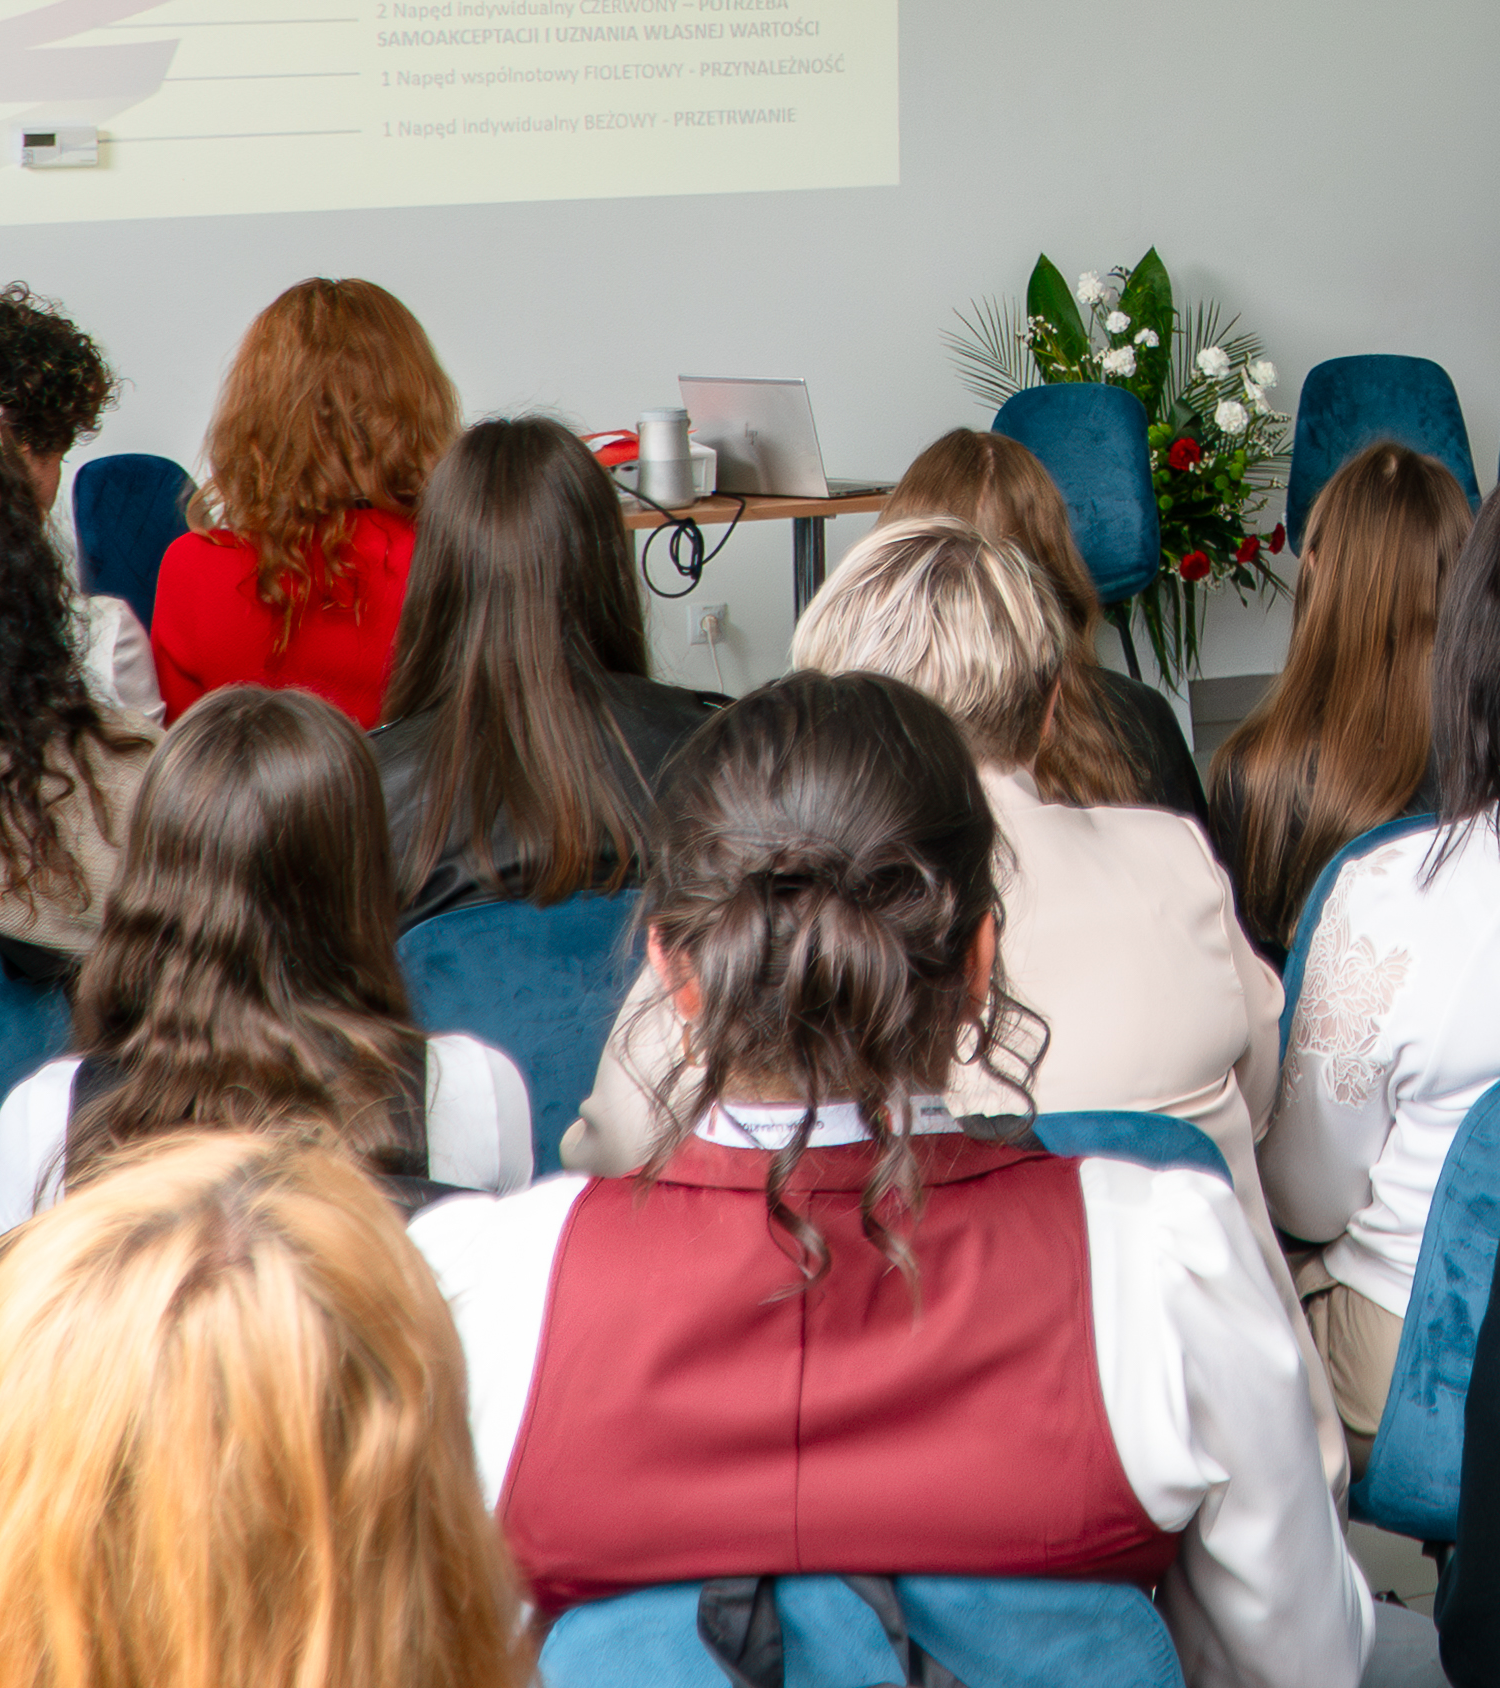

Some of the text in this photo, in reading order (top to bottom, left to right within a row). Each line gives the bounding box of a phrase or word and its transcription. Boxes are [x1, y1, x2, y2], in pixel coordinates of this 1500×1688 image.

[376, 2, 388, 20] 2
[393, 1, 453, 22] Napęd
[377, 27, 540, 48] SAMOAKCEPTACJI
[555, 25, 639, 43] UZNANIA
[643, 22, 725, 41] WŁASNEJ
[729, 17, 820, 39] WARTOŚCI
[381, 70, 391, 88] 1
[396, 68, 456, 89] Napęd
[460, 65, 580, 88] wspólnotowy
[584, 62, 685, 81] FIOLETOWY
[699, 53, 846, 78] PRZYNALEŻNOŚĆ
[383, 121, 393, 138] 1
[398, 118, 458, 140] Napęd
[462, 114, 580, 137] indywidualny
[584, 110, 658, 131] BEŻOWY
[673, 106, 797, 127] PRZETRWANIE
